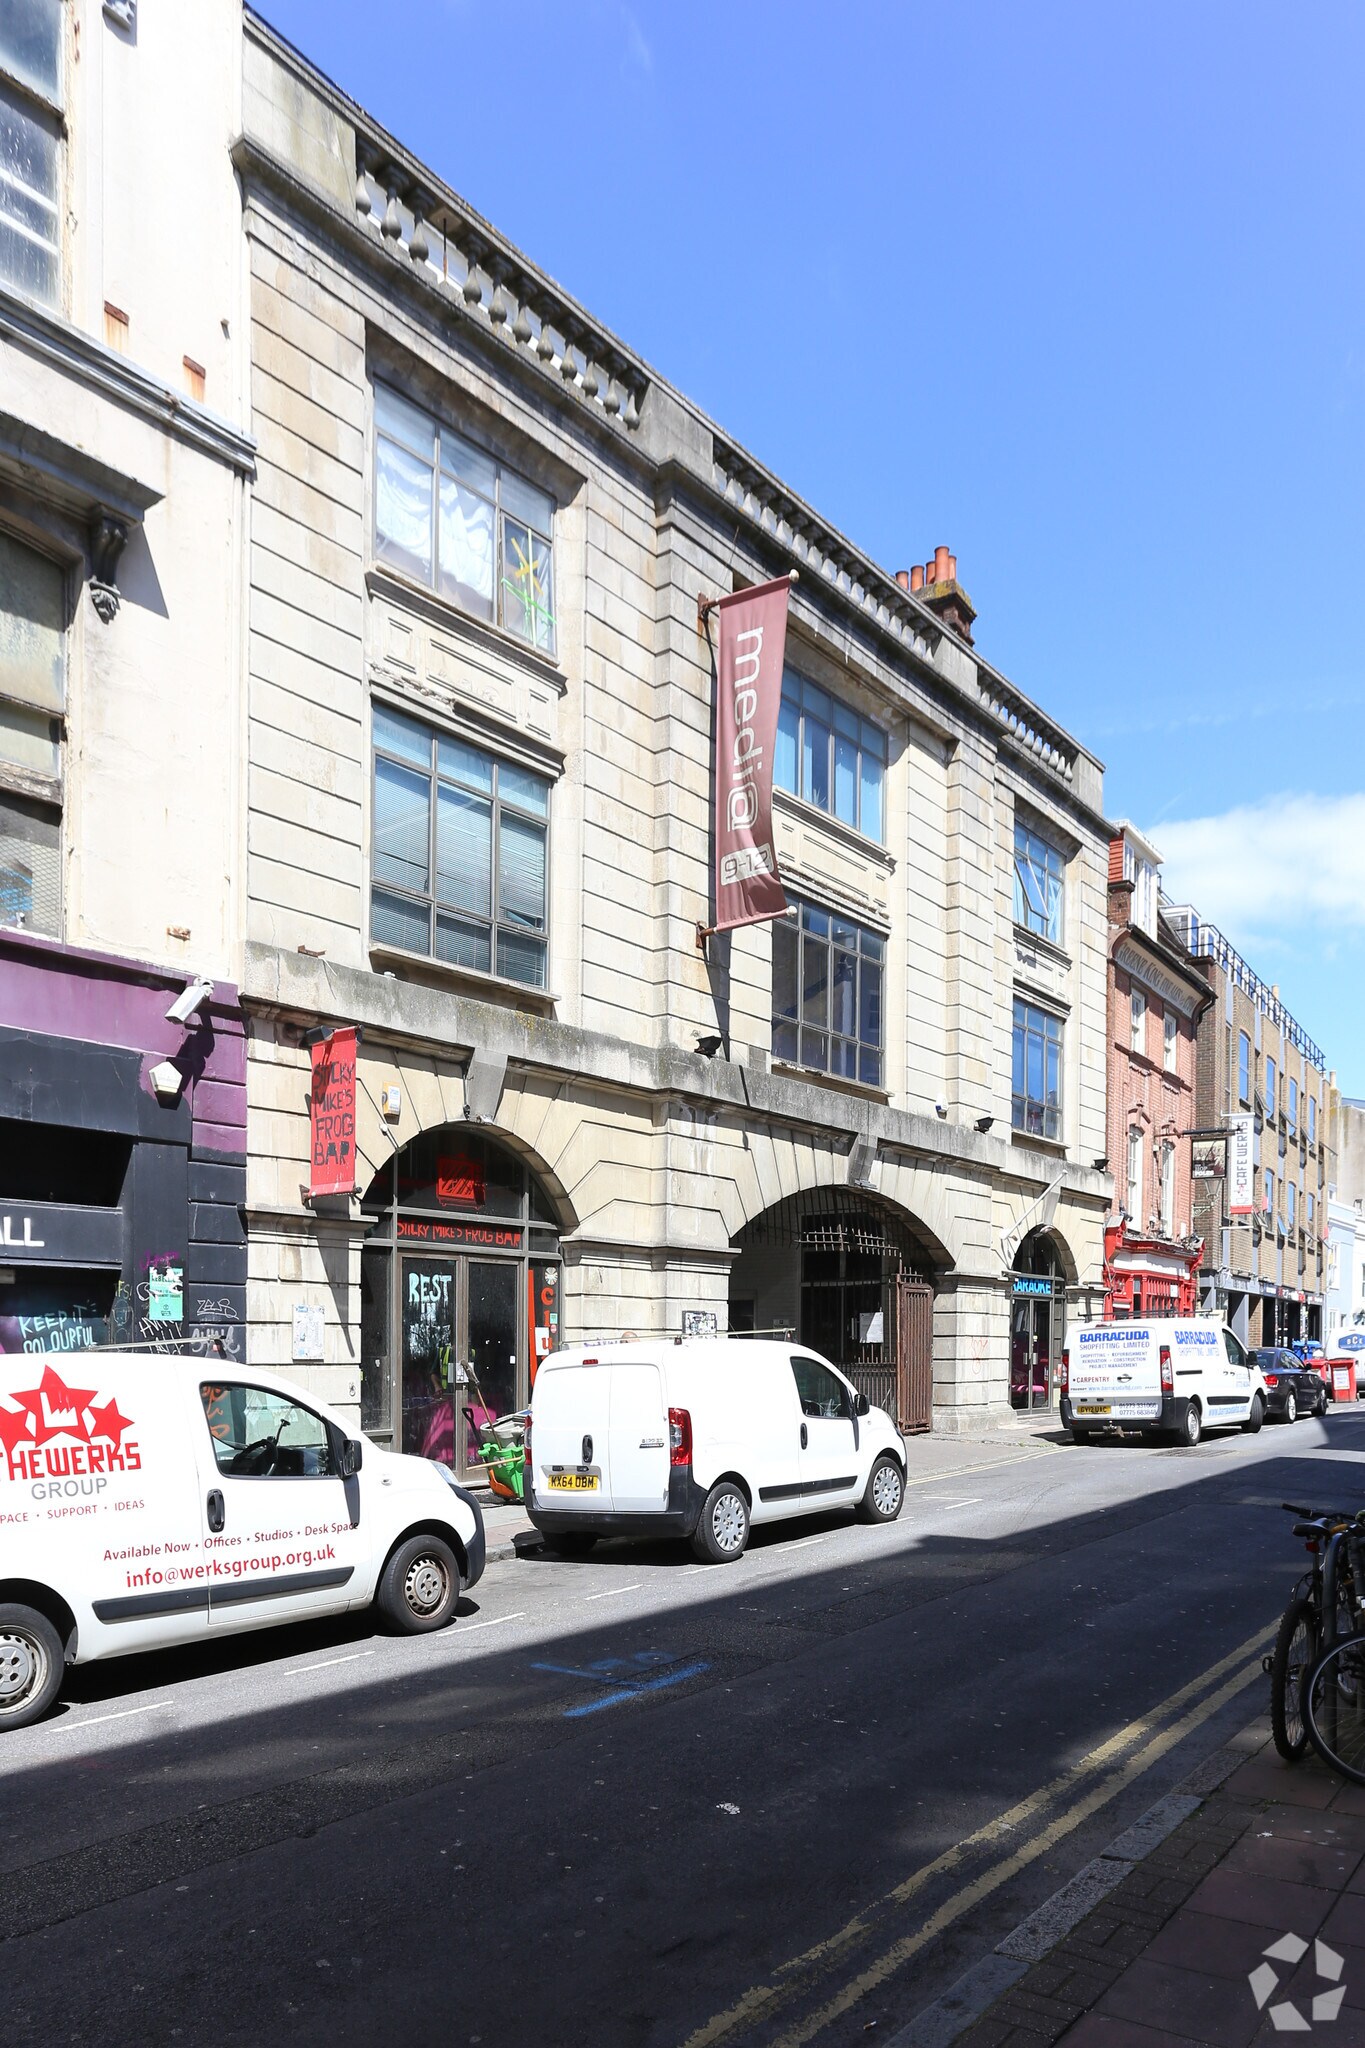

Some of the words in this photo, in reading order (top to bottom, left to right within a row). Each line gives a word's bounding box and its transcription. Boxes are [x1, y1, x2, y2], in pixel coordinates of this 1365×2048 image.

[723, 848, 770, 882] 9-12
[314, 1088, 354, 1118] MIKE'S
[316, 1113, 354, 1141] FROG
[314, 1141, 351, 1166] BAR
[1236, 1159, 1248, 1186] CAFE
[495, 1230, 521, 1247] BAR
[18, 1310, 68, 1338] KEEP
[72, 1304, 88, 1323] IT
[23, 1326, 98, 1353] COLOURFUL
[1079, 1331, 1150, 1342] BARRACUDA
[1079, 1342, 1121, 1350] SHOPFITTING
[1123, 1341, 1150, 1349] LIMITED
[1174, 1331, 1218, 1345] BARRACUDA
[1076, 1376, 1110, 1384] CARPENTRY
[0, 1442, 142, 1481] HEWERKS
[31, 1477, 108, 1500] GROUP
[551, 1476, 573, 1488] KX64
[47, 1504, 98, 1519] SUPPORT
[114, 1500, 145, 1511] IDEAS
[103, 1544, 161, 1561] Available
[164, 1542, 191, 1554] Now
[204, 1536, 242, 1549] Offices
[254, 1529, 294, 1543] Studios
[304, 1524, 329, 1537] Desk
[331, 1521, 359, 1534] Space
[126, 1544, 336, 1588] info@werksgroup.org.uk
